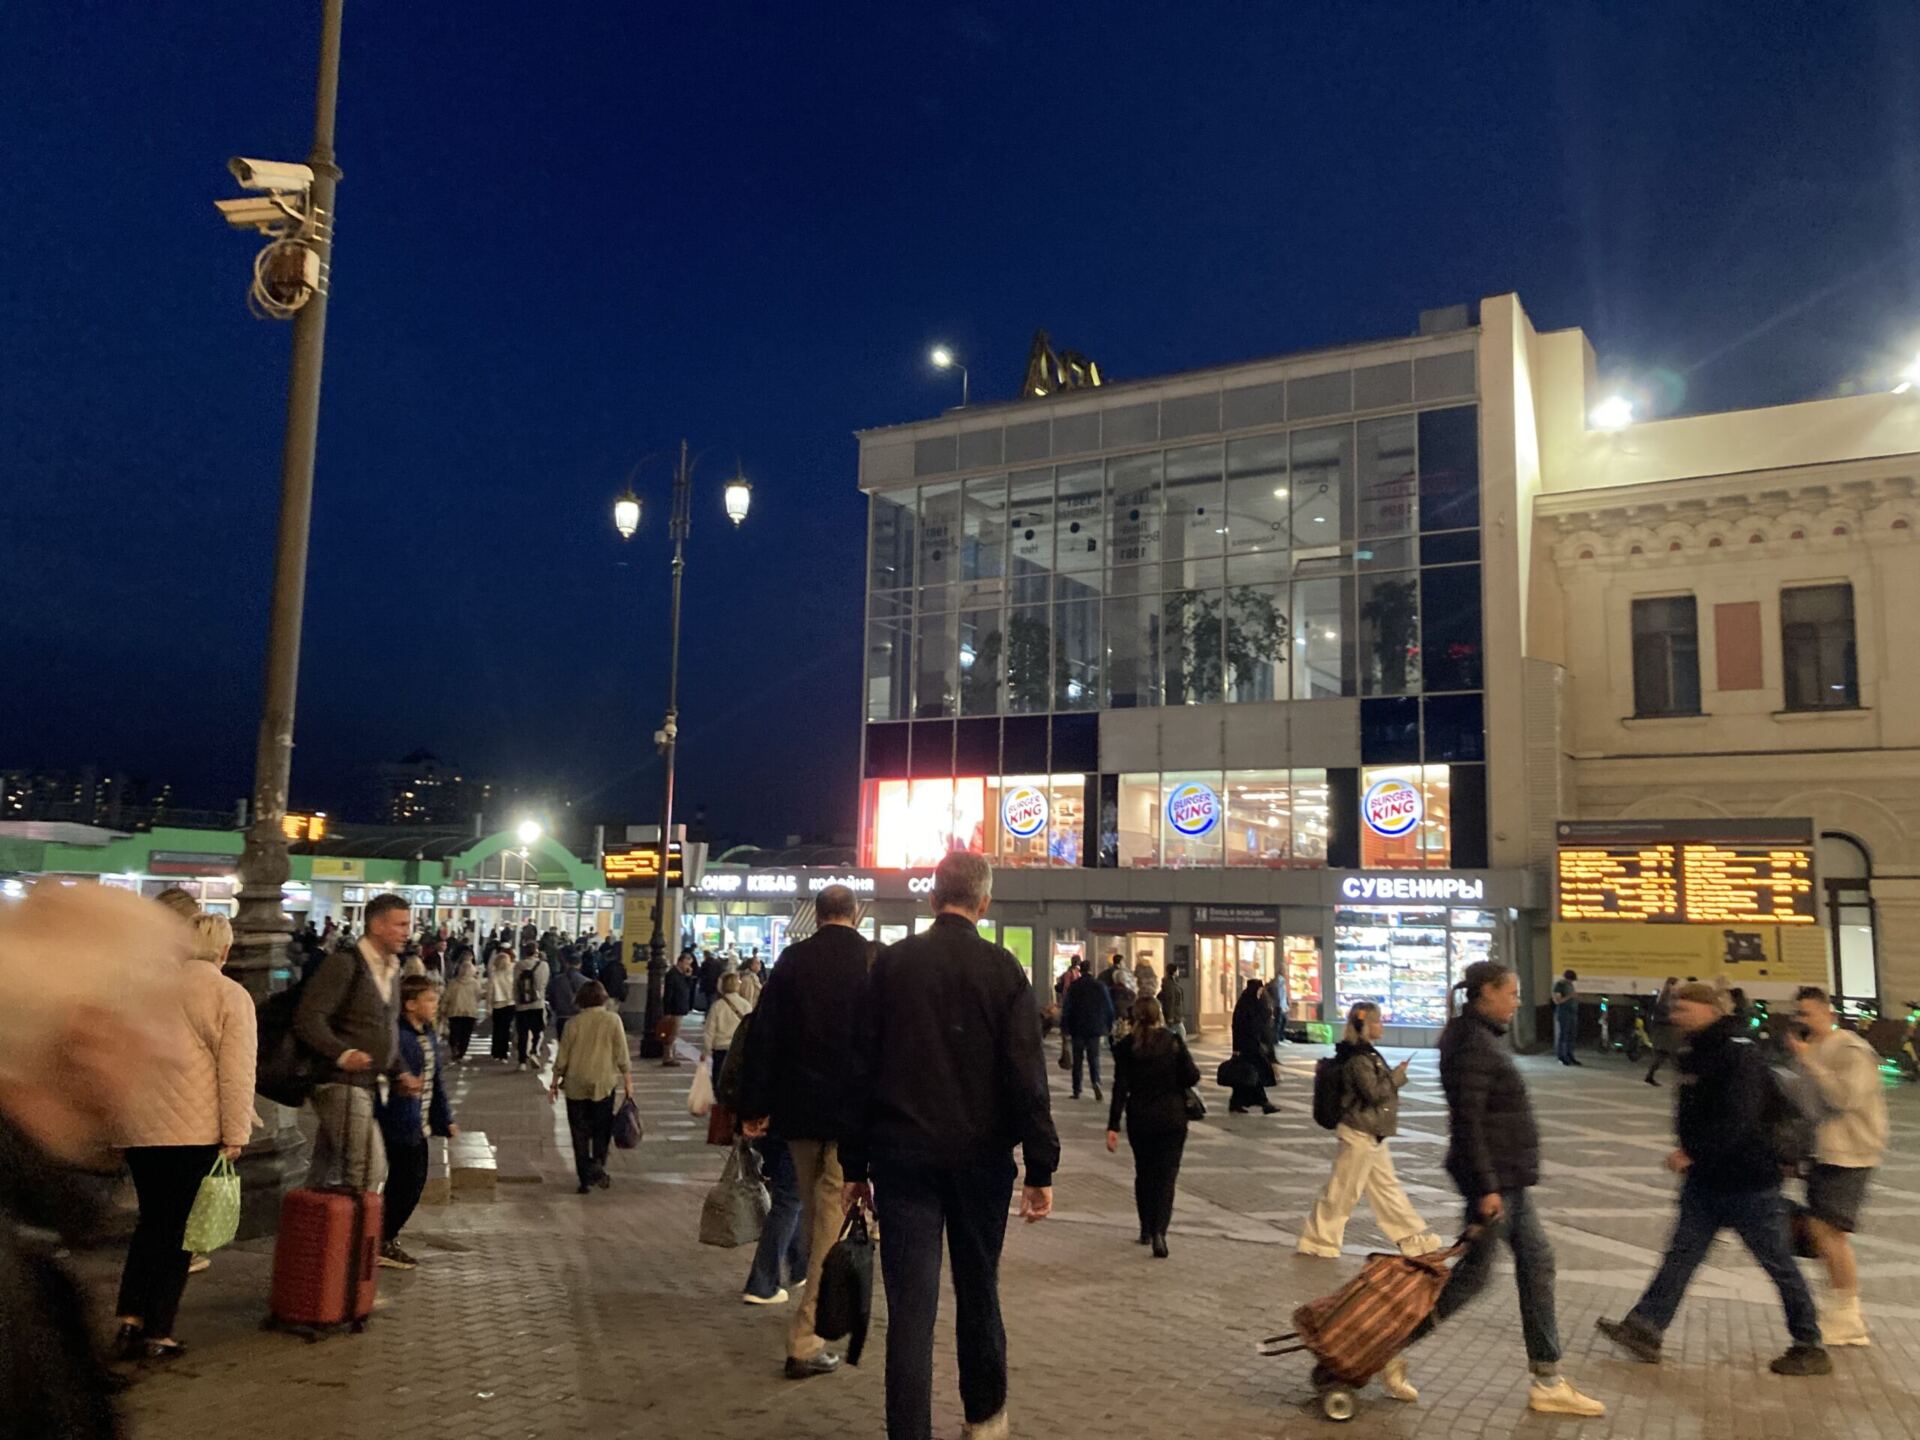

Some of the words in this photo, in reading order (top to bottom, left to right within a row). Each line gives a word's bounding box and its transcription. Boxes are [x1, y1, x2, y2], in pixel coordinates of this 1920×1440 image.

[1008, 795, 1042, 815] BURGER
[1173, 792, 1211, 811] BURGER
[1370, 789, 1415, 809] BURGER
[1010, 804, 1042, 825] KING
[1174, 802, 1213, 823] KING
[1372, 800, 1415, 822] KING
[690, 874, 742, 892] ОНЕР
[747, 874, 797, 892] КЕБАБ
[1342, 877, 1484, 899] СУВЕНИРЫ
